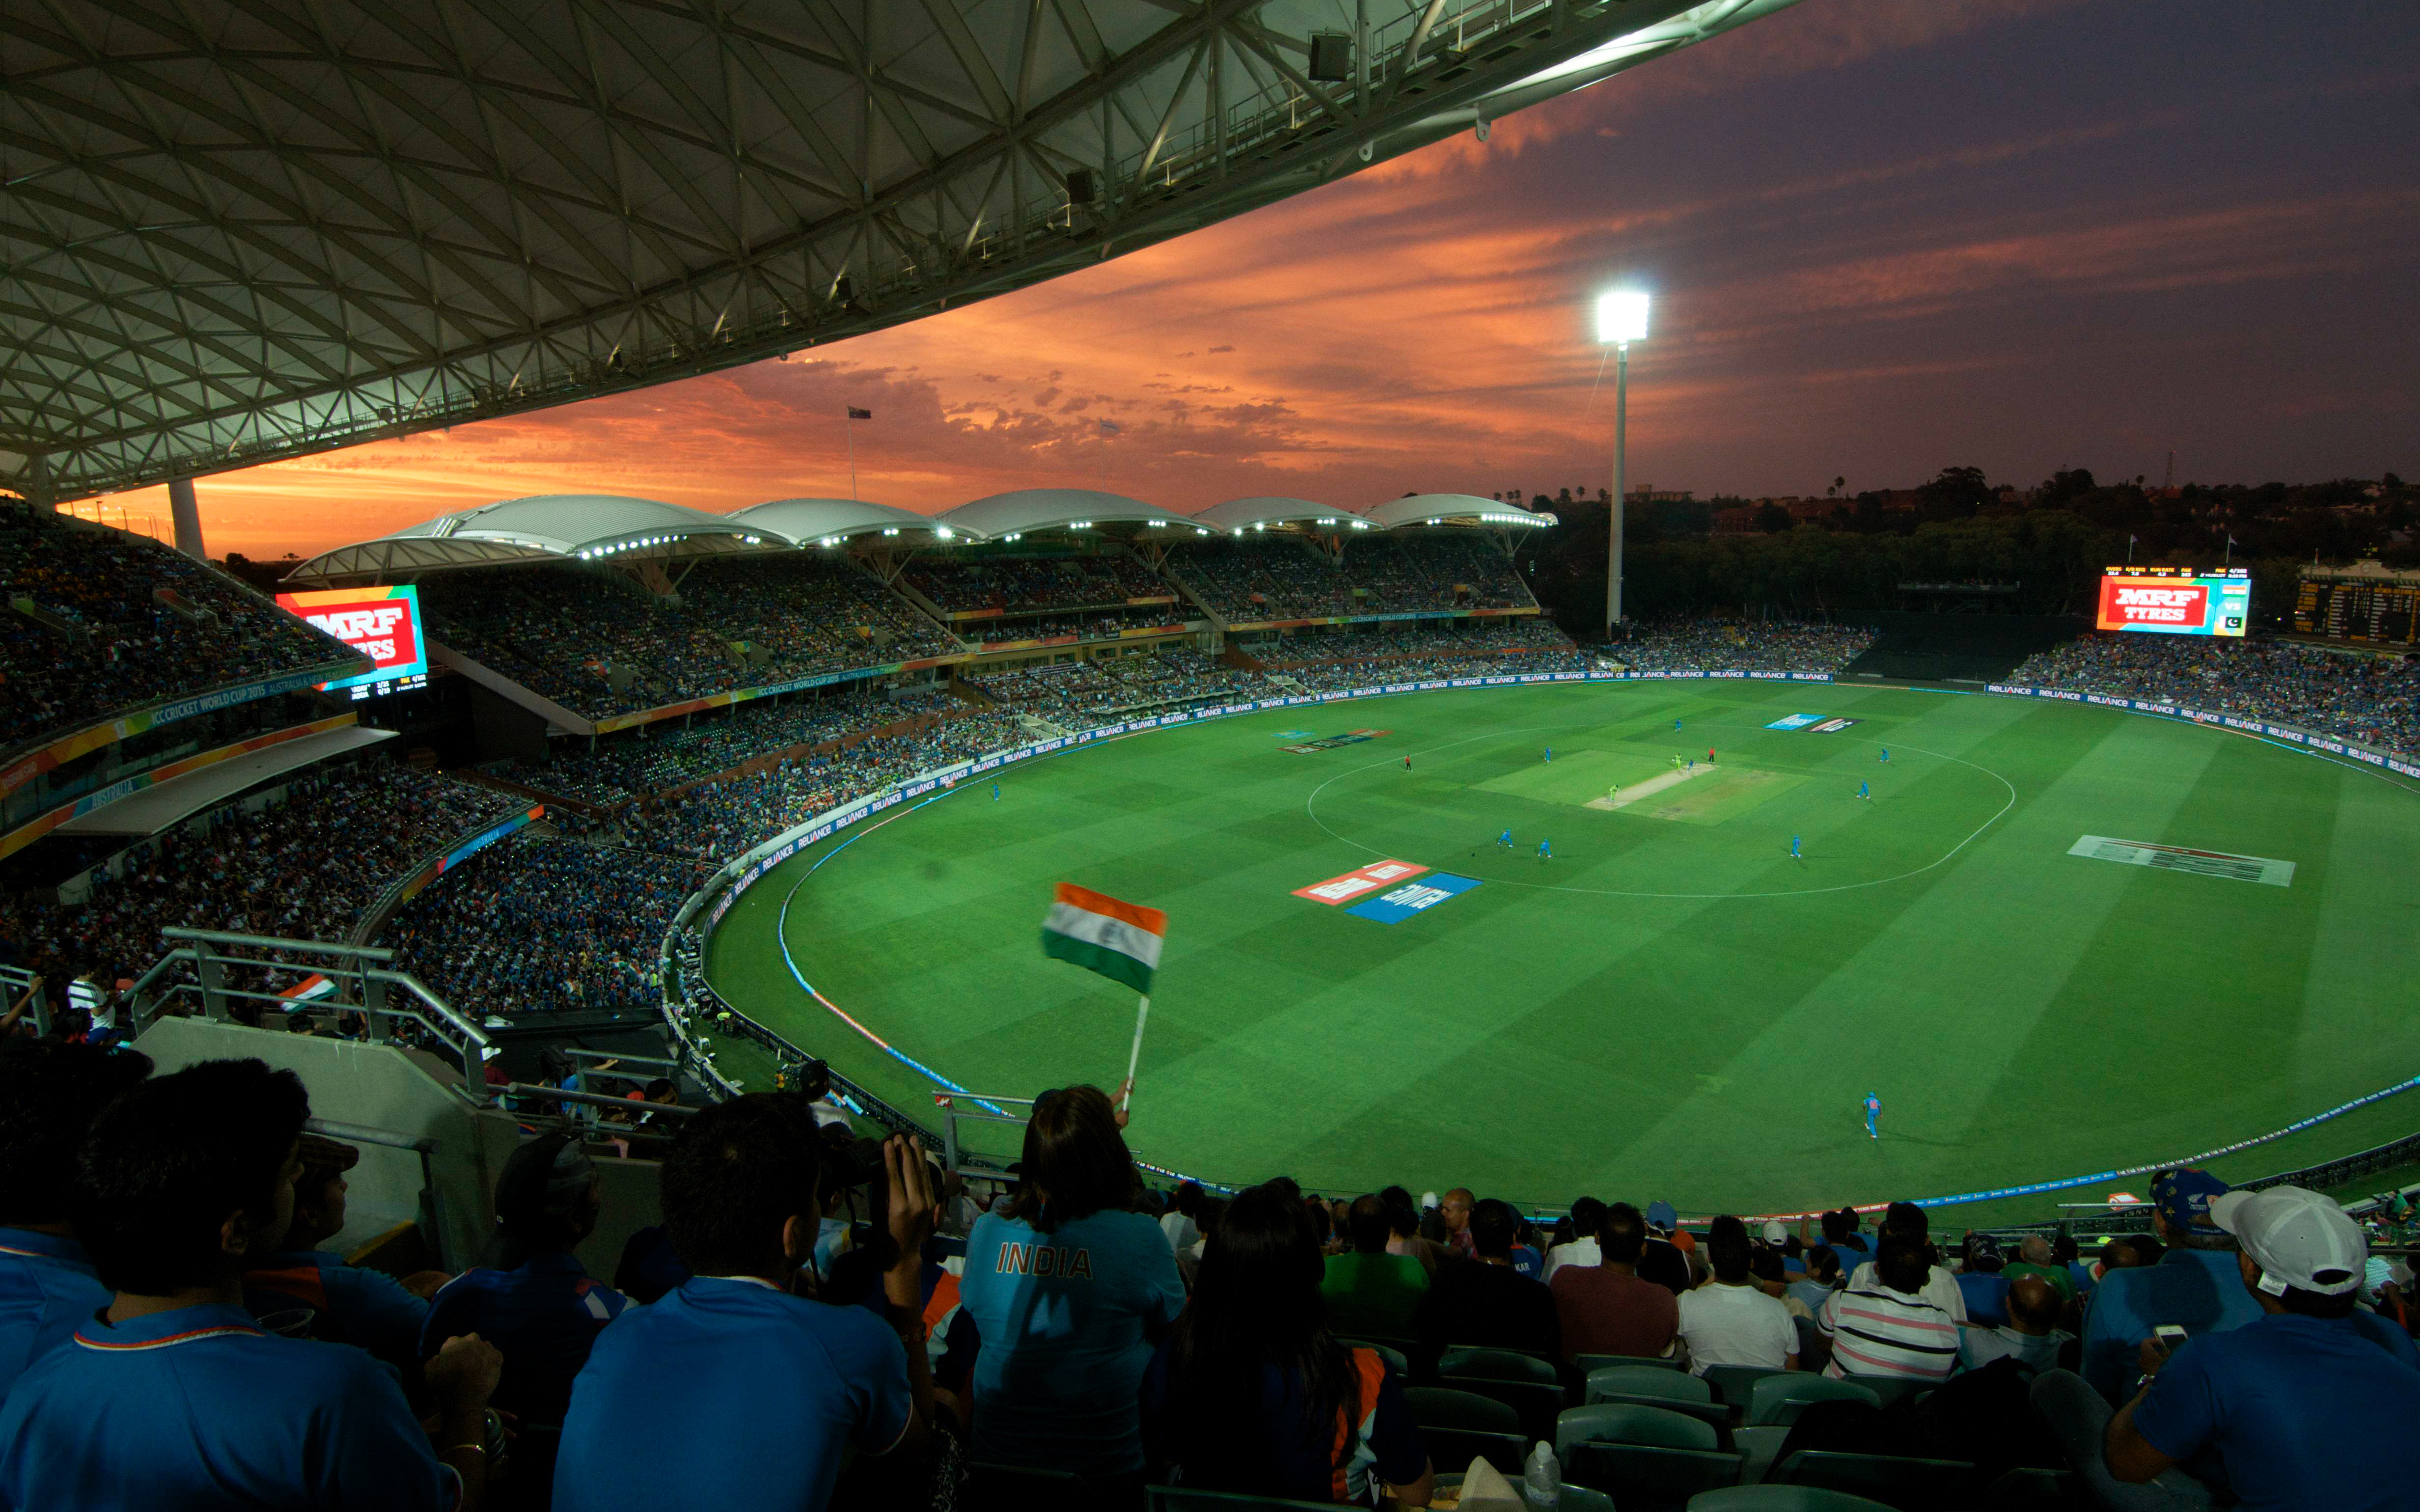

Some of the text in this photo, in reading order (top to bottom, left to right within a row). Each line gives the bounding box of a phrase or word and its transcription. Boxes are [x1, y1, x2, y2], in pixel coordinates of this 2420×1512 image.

[2116, 588, 2199, 607] MRF
[2125, 606, 2185, 621] TYRES
[1452, 678, 1482, 687] RELIANCE
[1486, 676, 1516, 685] RELIANCE
[1520, 674, 1550, 682] RELIANCE
[1554, 672, 1585, 681] RELIANCE
[1750, 671, 1786, 679] RELIANCE
[1792, 672, 1829, 681] RELIANCE
[758, 687, 768, 696] ICC
[769, 683, 793, 694] CRICKET
[794, 679, 816, 690] WORLD
[816, 677, 826, 686] CUP
[827, 674, 839, 684] 2015
[1353, 687, 1382, 697] RELIANCE
[1385, 684, 1415, 693] RELIANCE
[1419, 680, 1448, 690] RELIANCE
[1988, 685, 2032, 695] RELIANCE
[151, 710, 165, 725] ICC
[165, 701, 198, 720] CRICKET
[200, 693, 230, 711] WORLD
[230, 688, 247, 703] CUP
[248, 685, 265, 699] 2015
[270, 678, 302, 693] AUSTRALIA
[2038, 689, 2081, 701] RELIANCE
[2087, 695, 2128, 707] RELIANCE
[1225, 703, 1253, 714] RELIANCE
[2135, 701, 2175, 715] RELIANCE
[1160, 713, 1188, 725] RELIANCE
[2181, 709, 2219, 723] RELIANCE
[1095, 725, 1124, 739] RELIANCE
[2225, 717, 2262, 732] RELIANCE
[2267, 726, 2303, 742] RELIANCE
[1035, 740, 1061, 754] RELIANCE
[2308, 736, 2343, 753] RELIANCE
[1004, 748, 1031, 764] RELIANCE
[2347, 747, 2383, 766] RELIANCE
[971, 758, 1000, 774] RELIANCE
[2388, 759, 2420, 778] RELIANCE
[939, 768, 968, 786] RELIANCE
[906, 780, 936, 798] RELIANCE
[872, 792, 902, 813] RELIANCE
[836, 807, 868, 830] RELIANCE
[798, 825, 831, 850] RELIANCE
[762, 844, 794, 871] RELIANCE
[734, 866, 759, 896] RELIANCE
[712, 892, 733, 924] RELIANCE
[995, 1241, 1093, 1280] INDIA
